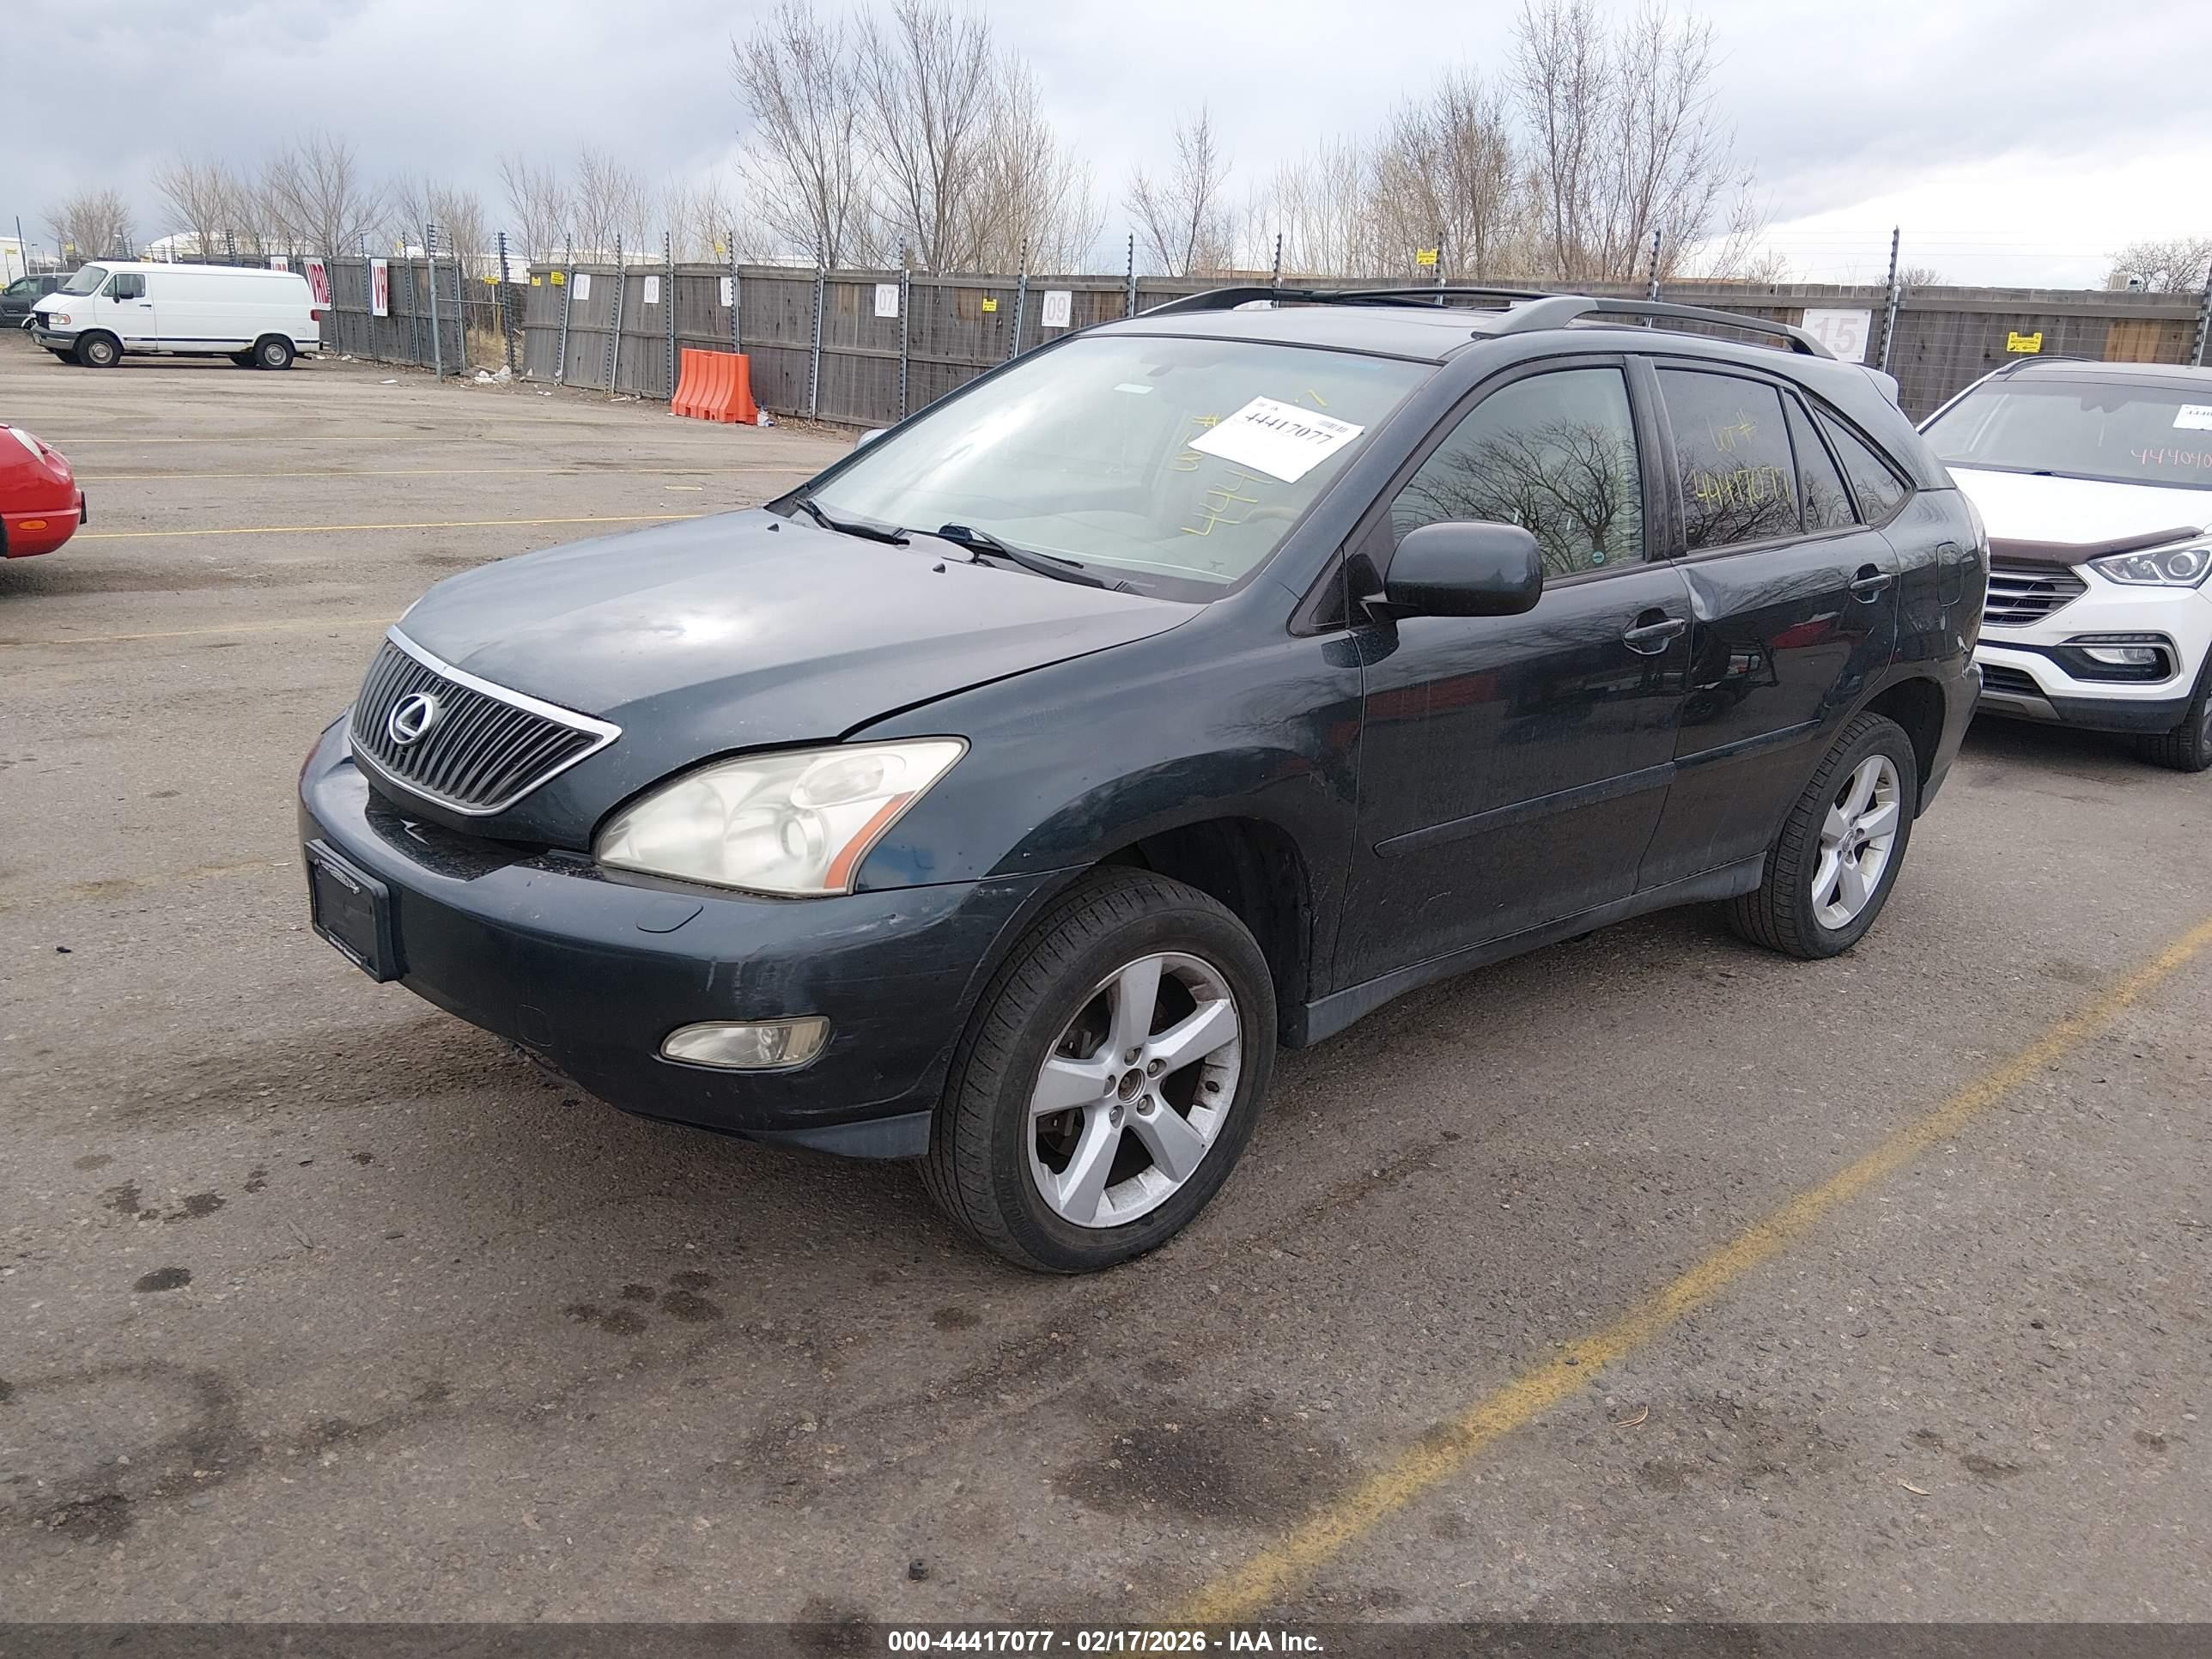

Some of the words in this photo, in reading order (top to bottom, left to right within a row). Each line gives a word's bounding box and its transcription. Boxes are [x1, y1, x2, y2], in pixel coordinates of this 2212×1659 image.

[878, 289, 896, 312] 07
[1046, 295, 1066, 321] 09
[1813, 316, 1858, 360] 15
[1245, 412, 1335, 445] 44417077
